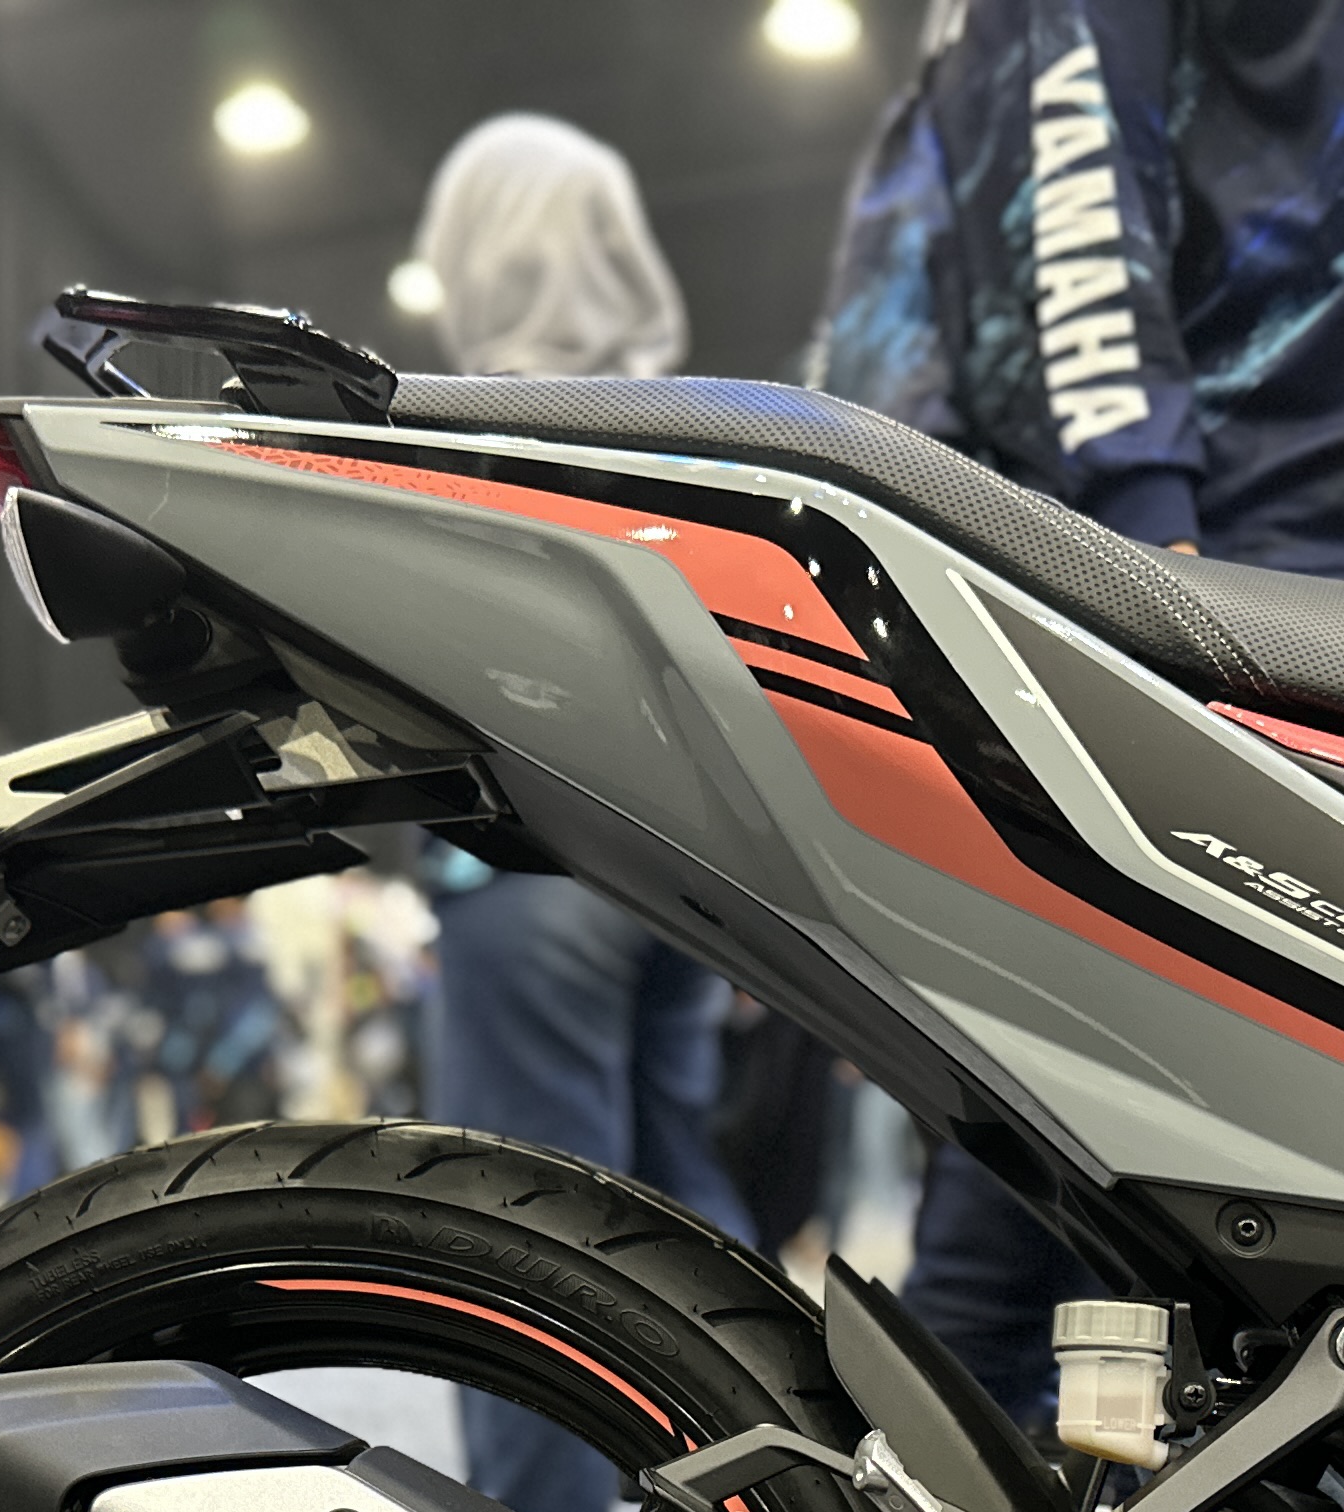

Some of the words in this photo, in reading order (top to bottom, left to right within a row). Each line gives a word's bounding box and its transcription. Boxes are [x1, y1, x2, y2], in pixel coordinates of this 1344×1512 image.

[1030, 44, 1150, 455] YAMAHA
[1169, 831, 1321, 901] A&S
[28, 1248, 102, 1290] TUBELESS
[1103, 1415, 1137, 1432] LOWER
